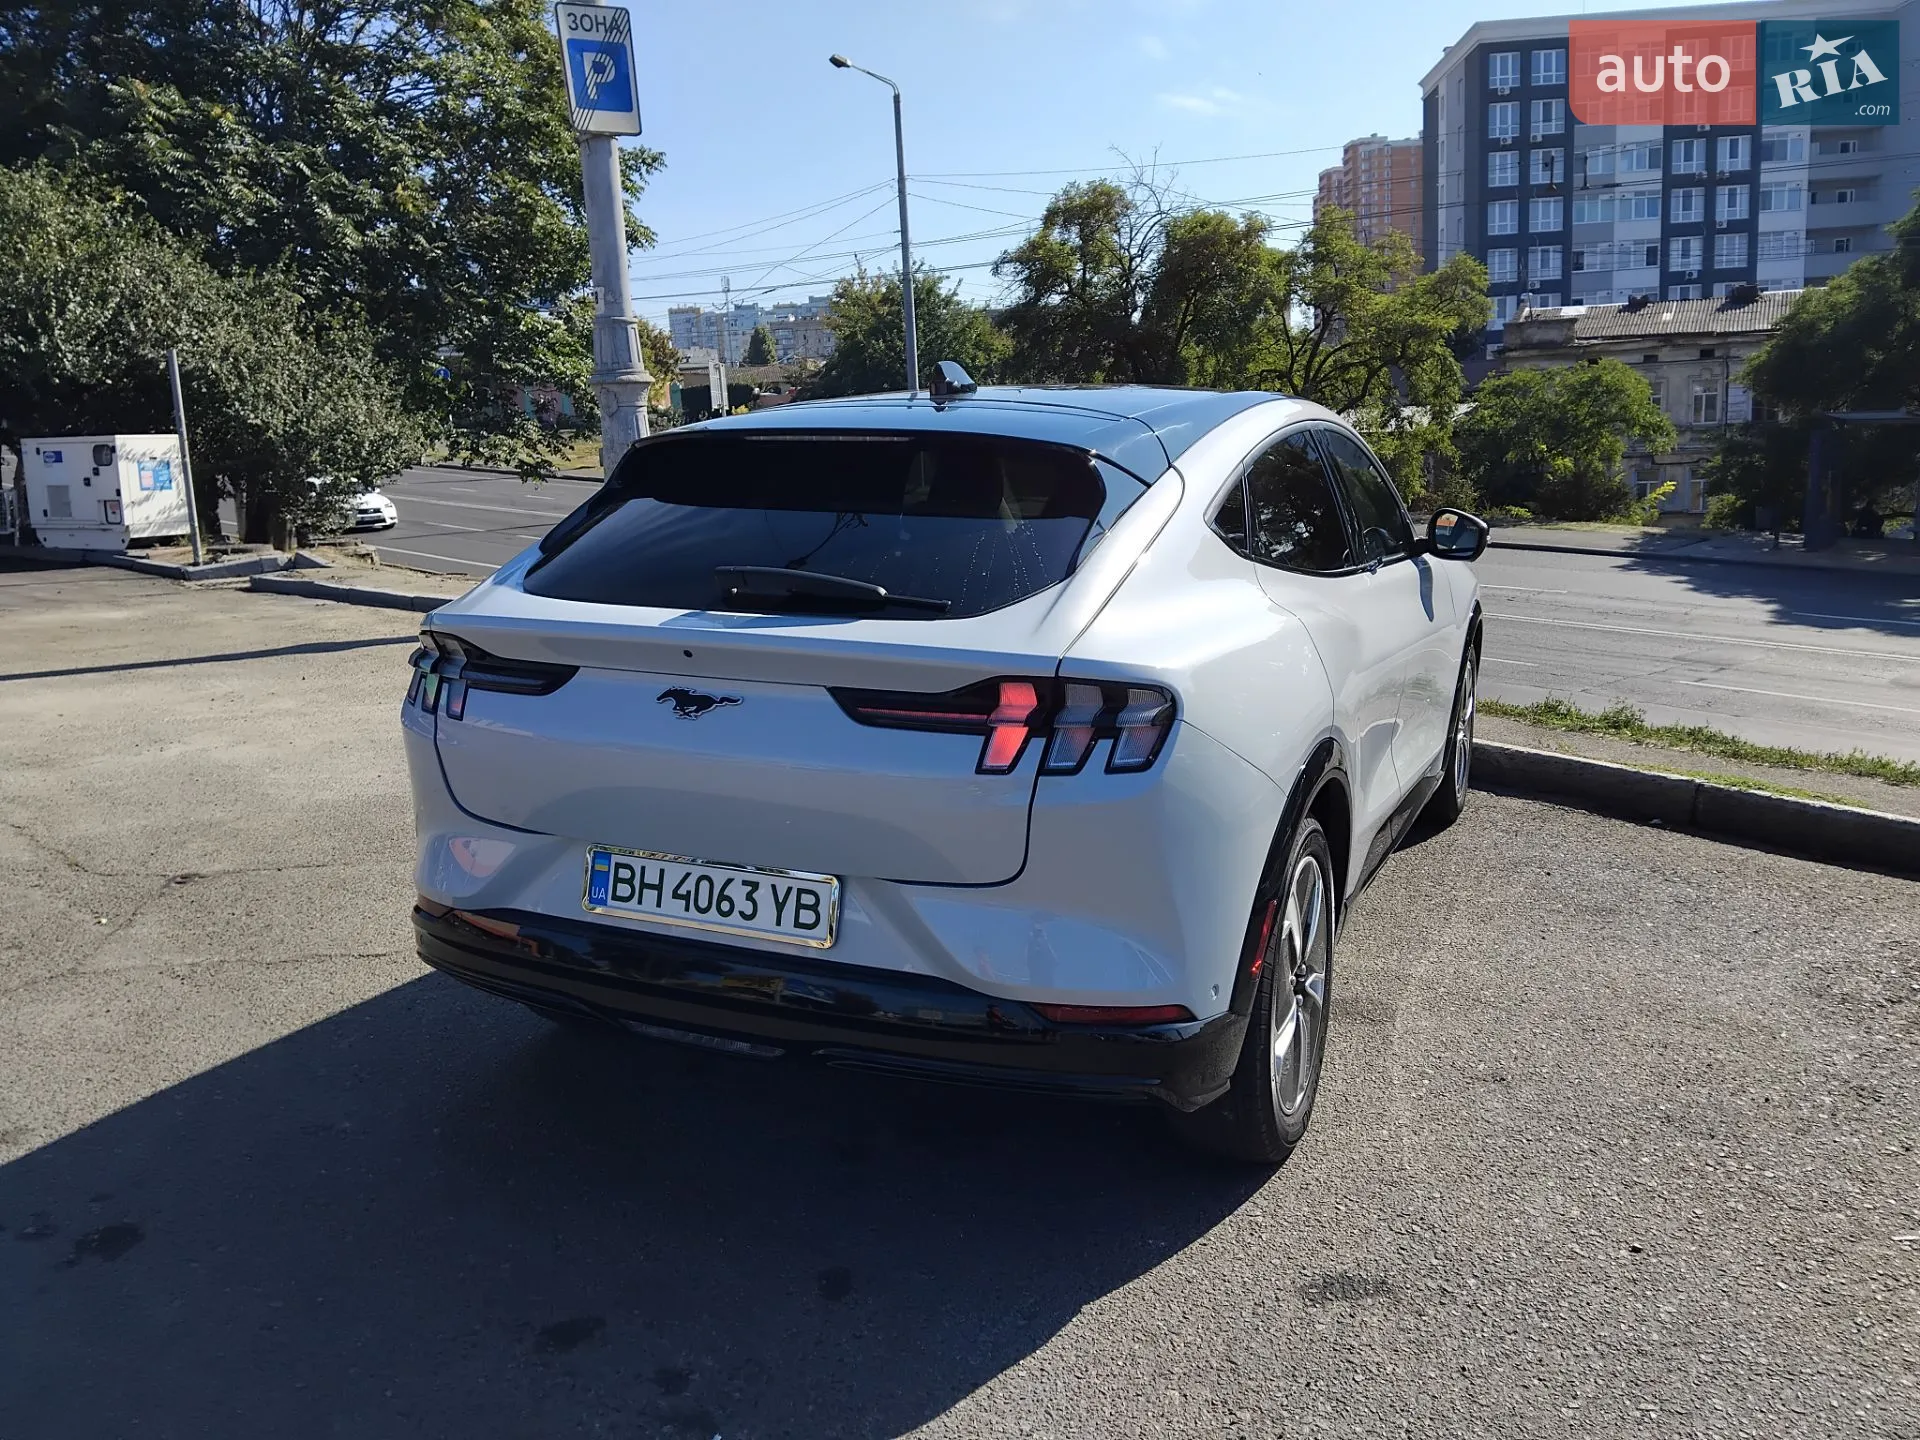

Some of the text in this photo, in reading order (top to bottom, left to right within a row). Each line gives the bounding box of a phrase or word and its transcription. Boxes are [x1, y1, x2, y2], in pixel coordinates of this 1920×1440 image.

[567, 13, 622, 33] ЗОНА
[582, 52, 616, 99] P
[591, 886, 606, 900] UA
[610, 862, 821, 930] BH 4063 YB
